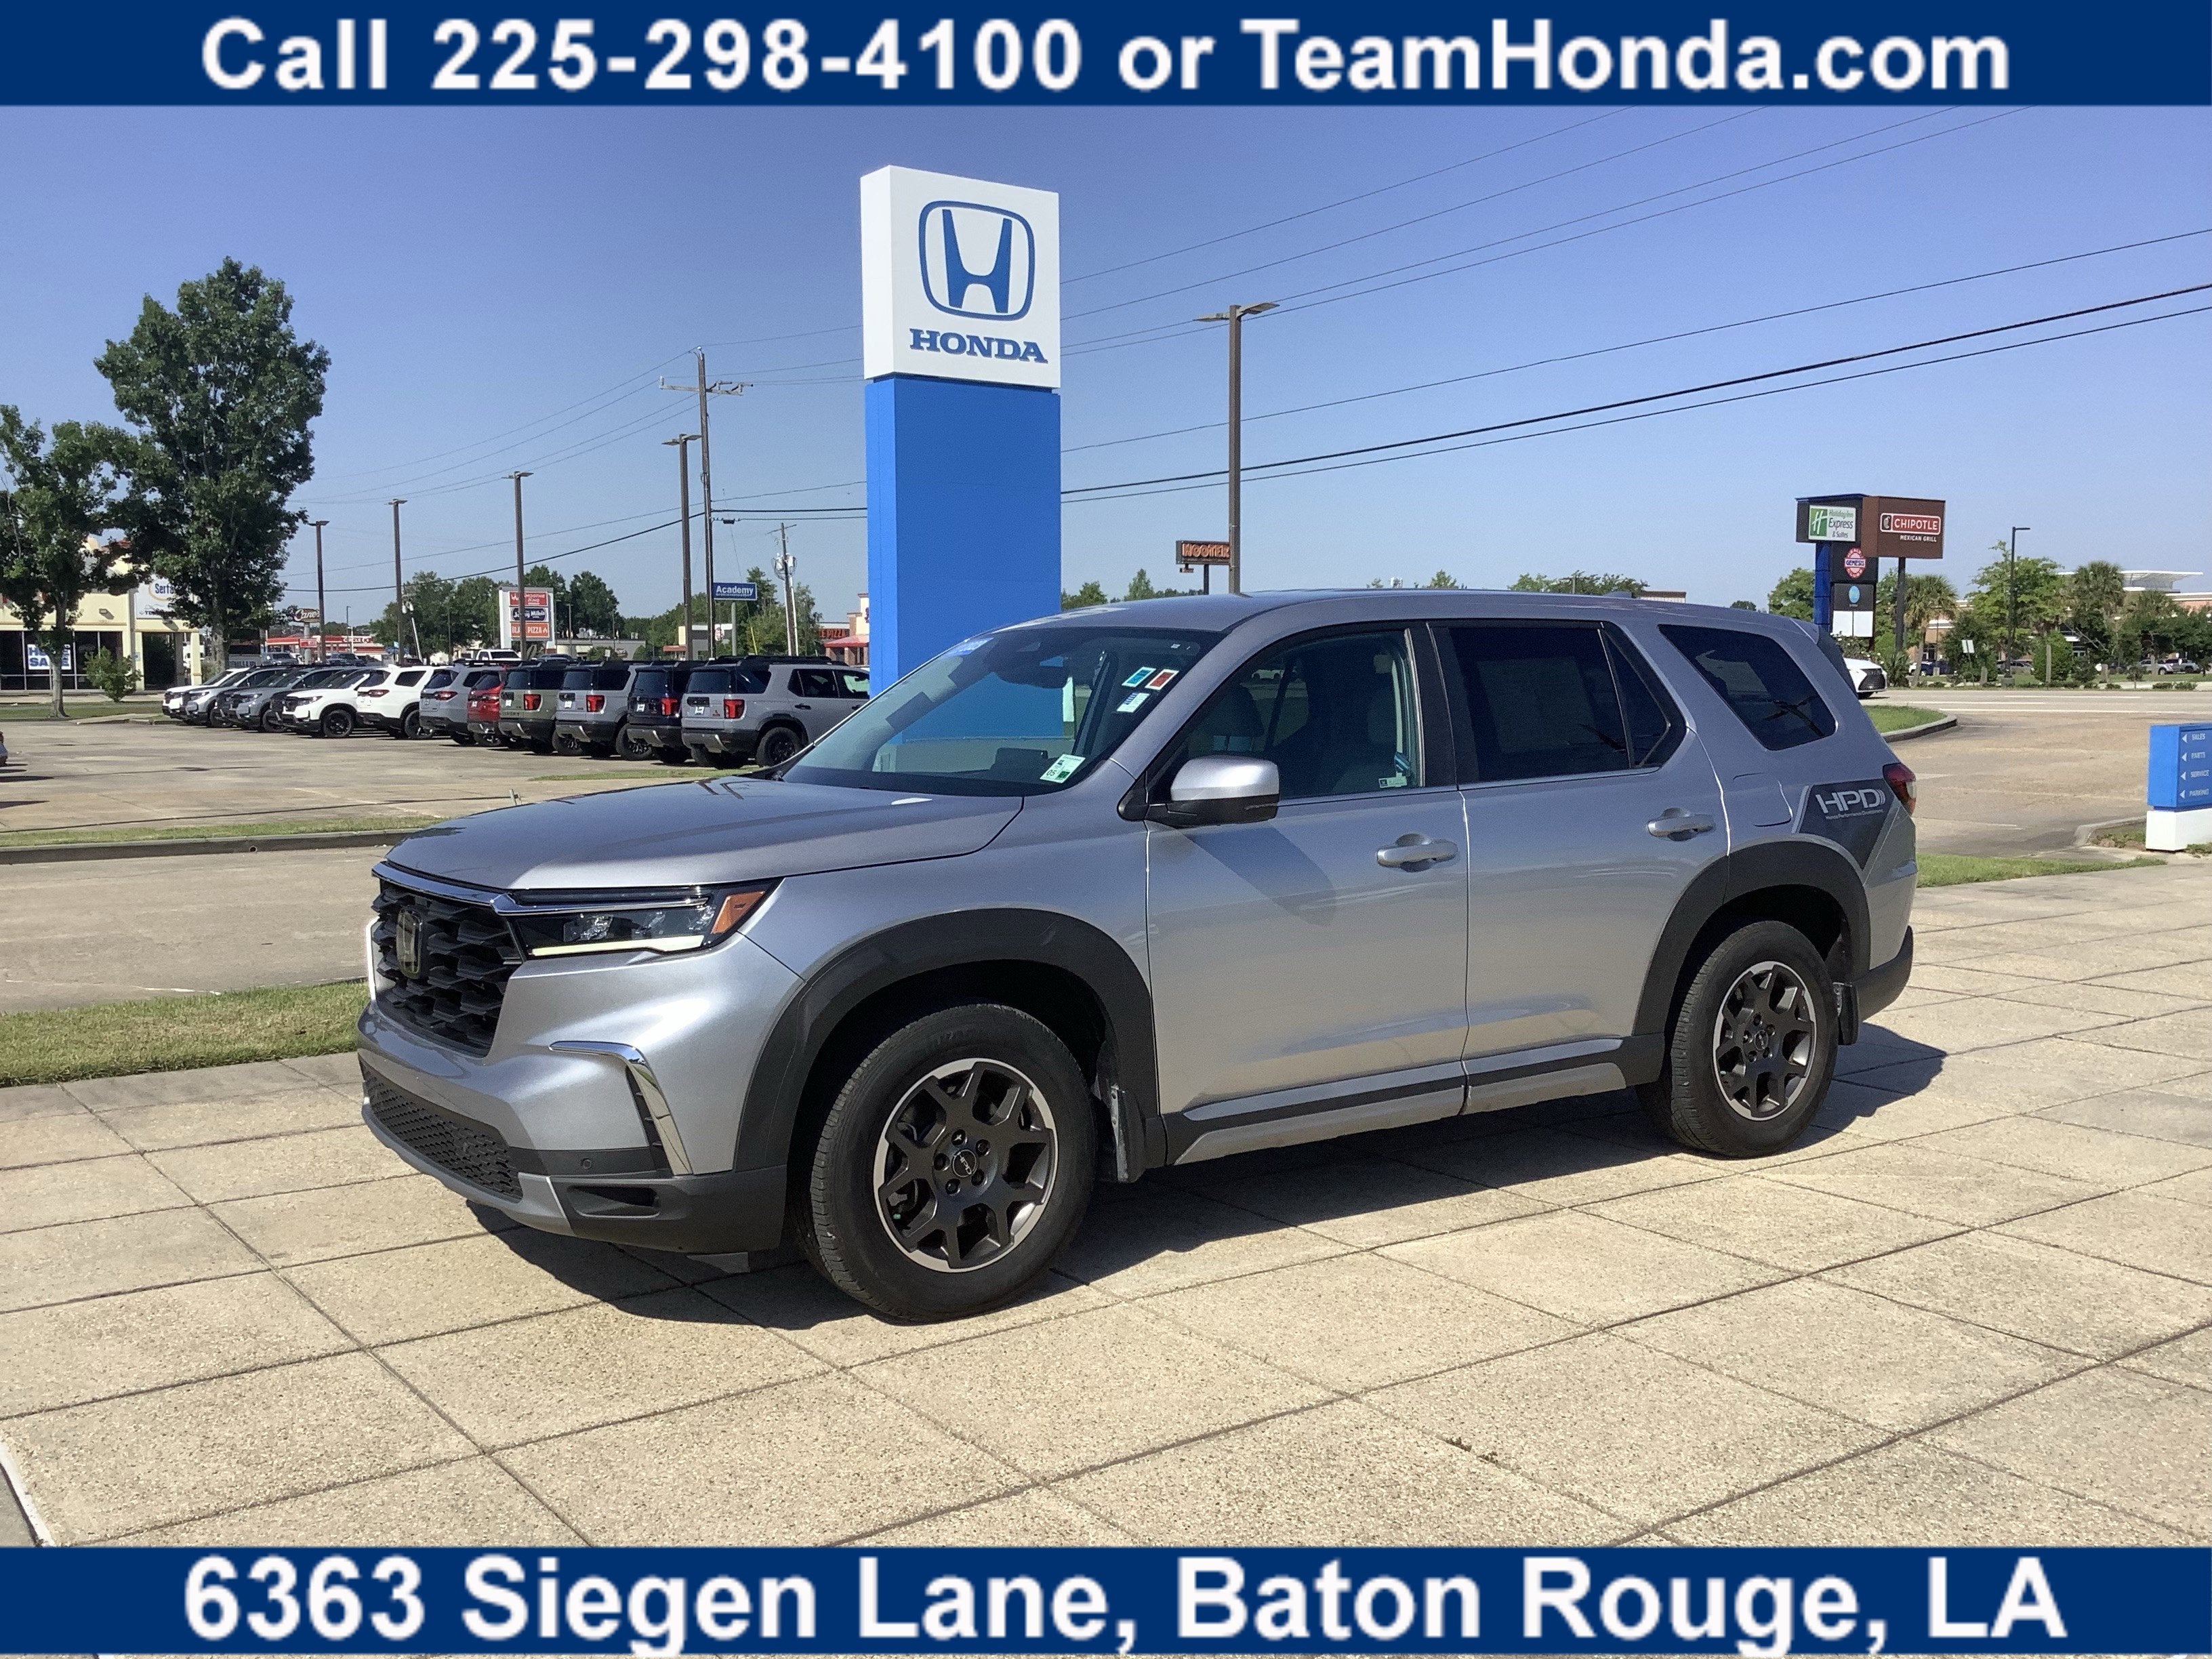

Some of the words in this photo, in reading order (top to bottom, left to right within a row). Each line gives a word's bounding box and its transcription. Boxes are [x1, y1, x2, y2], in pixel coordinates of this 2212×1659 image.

[909, 328, 1048, 364] HONDA
[1829, 518, 1853, 531] Express
[1894, 518, 1938, 531] CHIPOTLE
[1182, 544, 1230, 558] HOOTER
[716, 585, 754, 596] Academy
[1816, 788, 1881, 814] HPD
